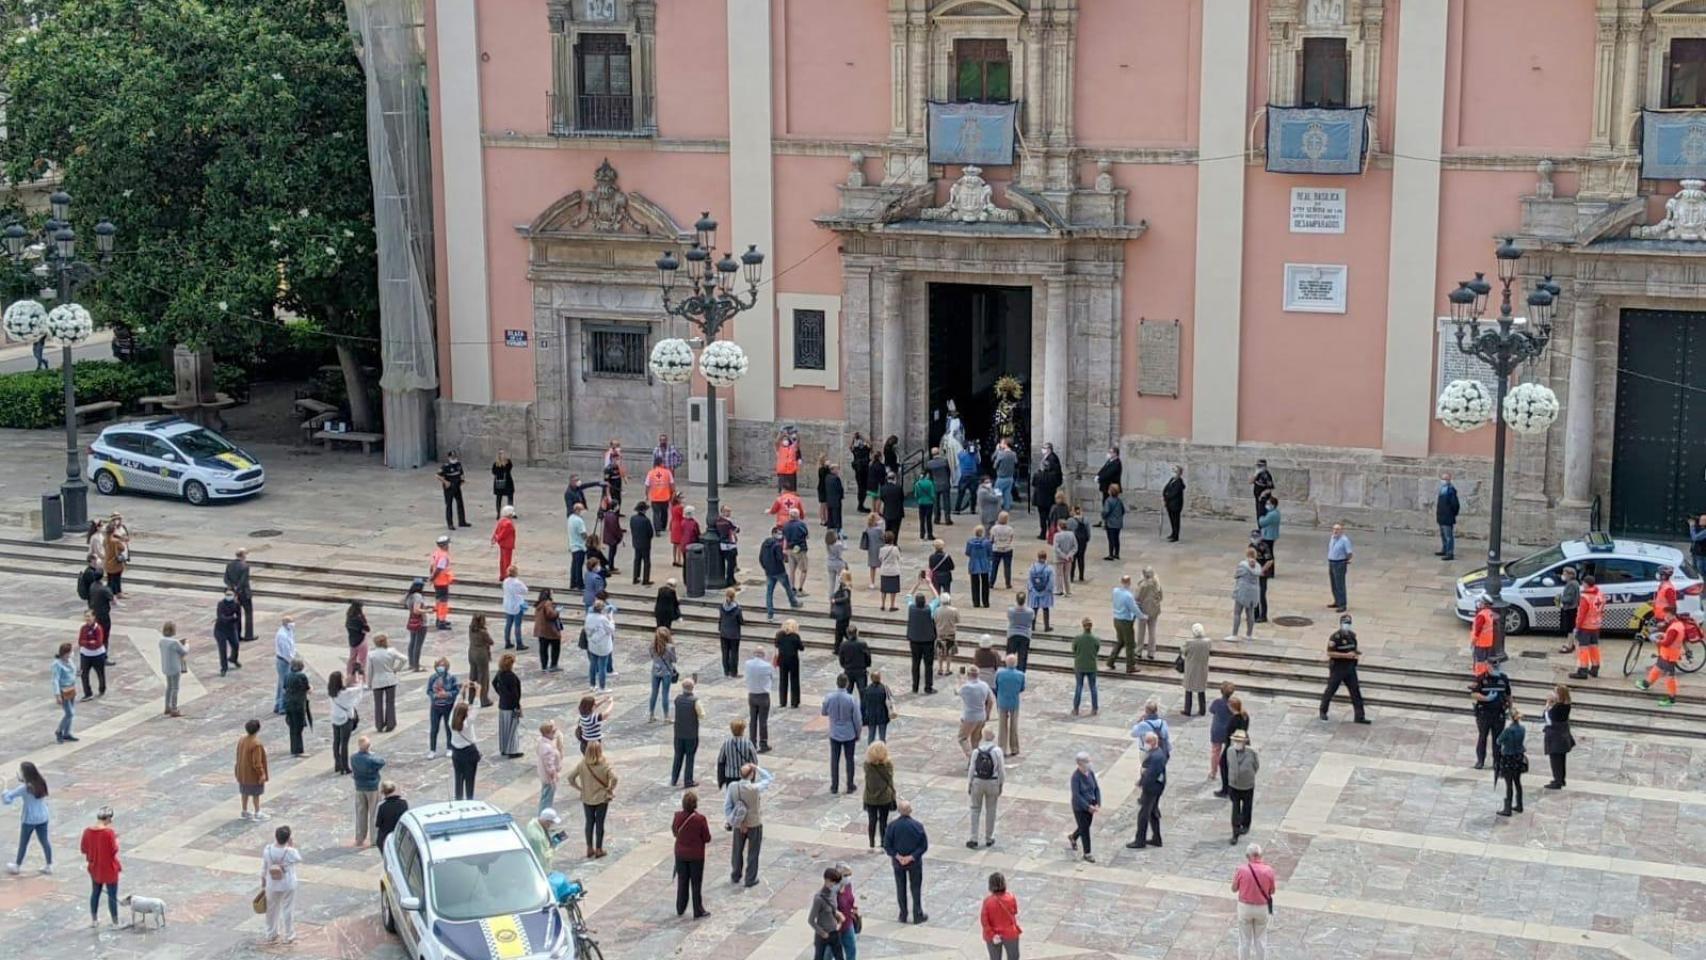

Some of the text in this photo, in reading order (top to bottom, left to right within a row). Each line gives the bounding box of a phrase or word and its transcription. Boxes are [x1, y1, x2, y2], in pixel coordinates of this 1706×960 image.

[1296, 192, 1311, 201] REAL
[121, 457, 141, 469] PLV
[1604, 593, 1632, 603] PLV
